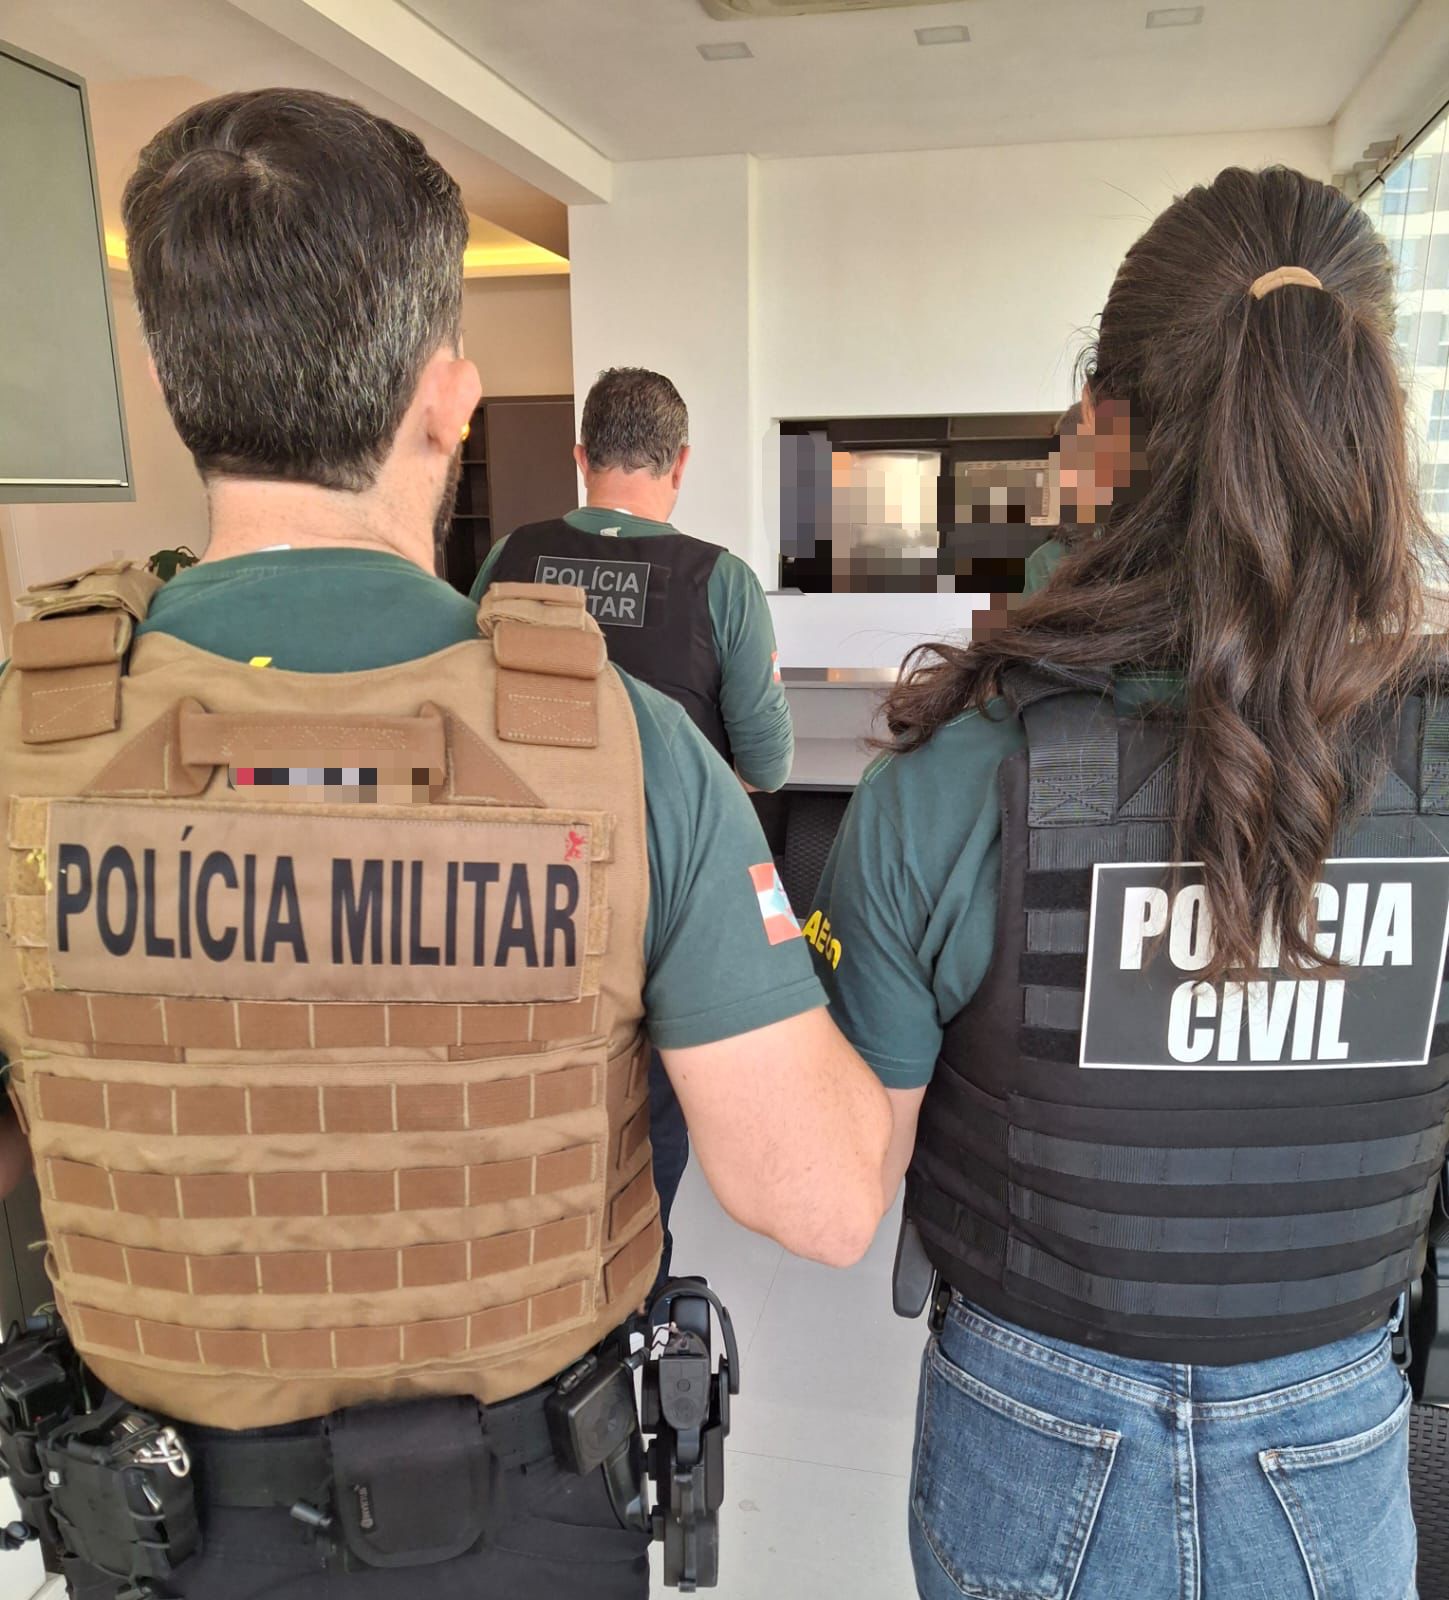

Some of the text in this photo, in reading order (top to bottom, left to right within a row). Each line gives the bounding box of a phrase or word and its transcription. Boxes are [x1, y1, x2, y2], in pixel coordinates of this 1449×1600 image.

[541, 565, 640, 593] POLÍCIA
[588, 594, 636, 619] TAR
[56, 825, 581, 968] POLÍCIA MILITAR
[1119, 882, 1413, 971] POCIA
[1167, 979, 1349, 1063] CIVIL
